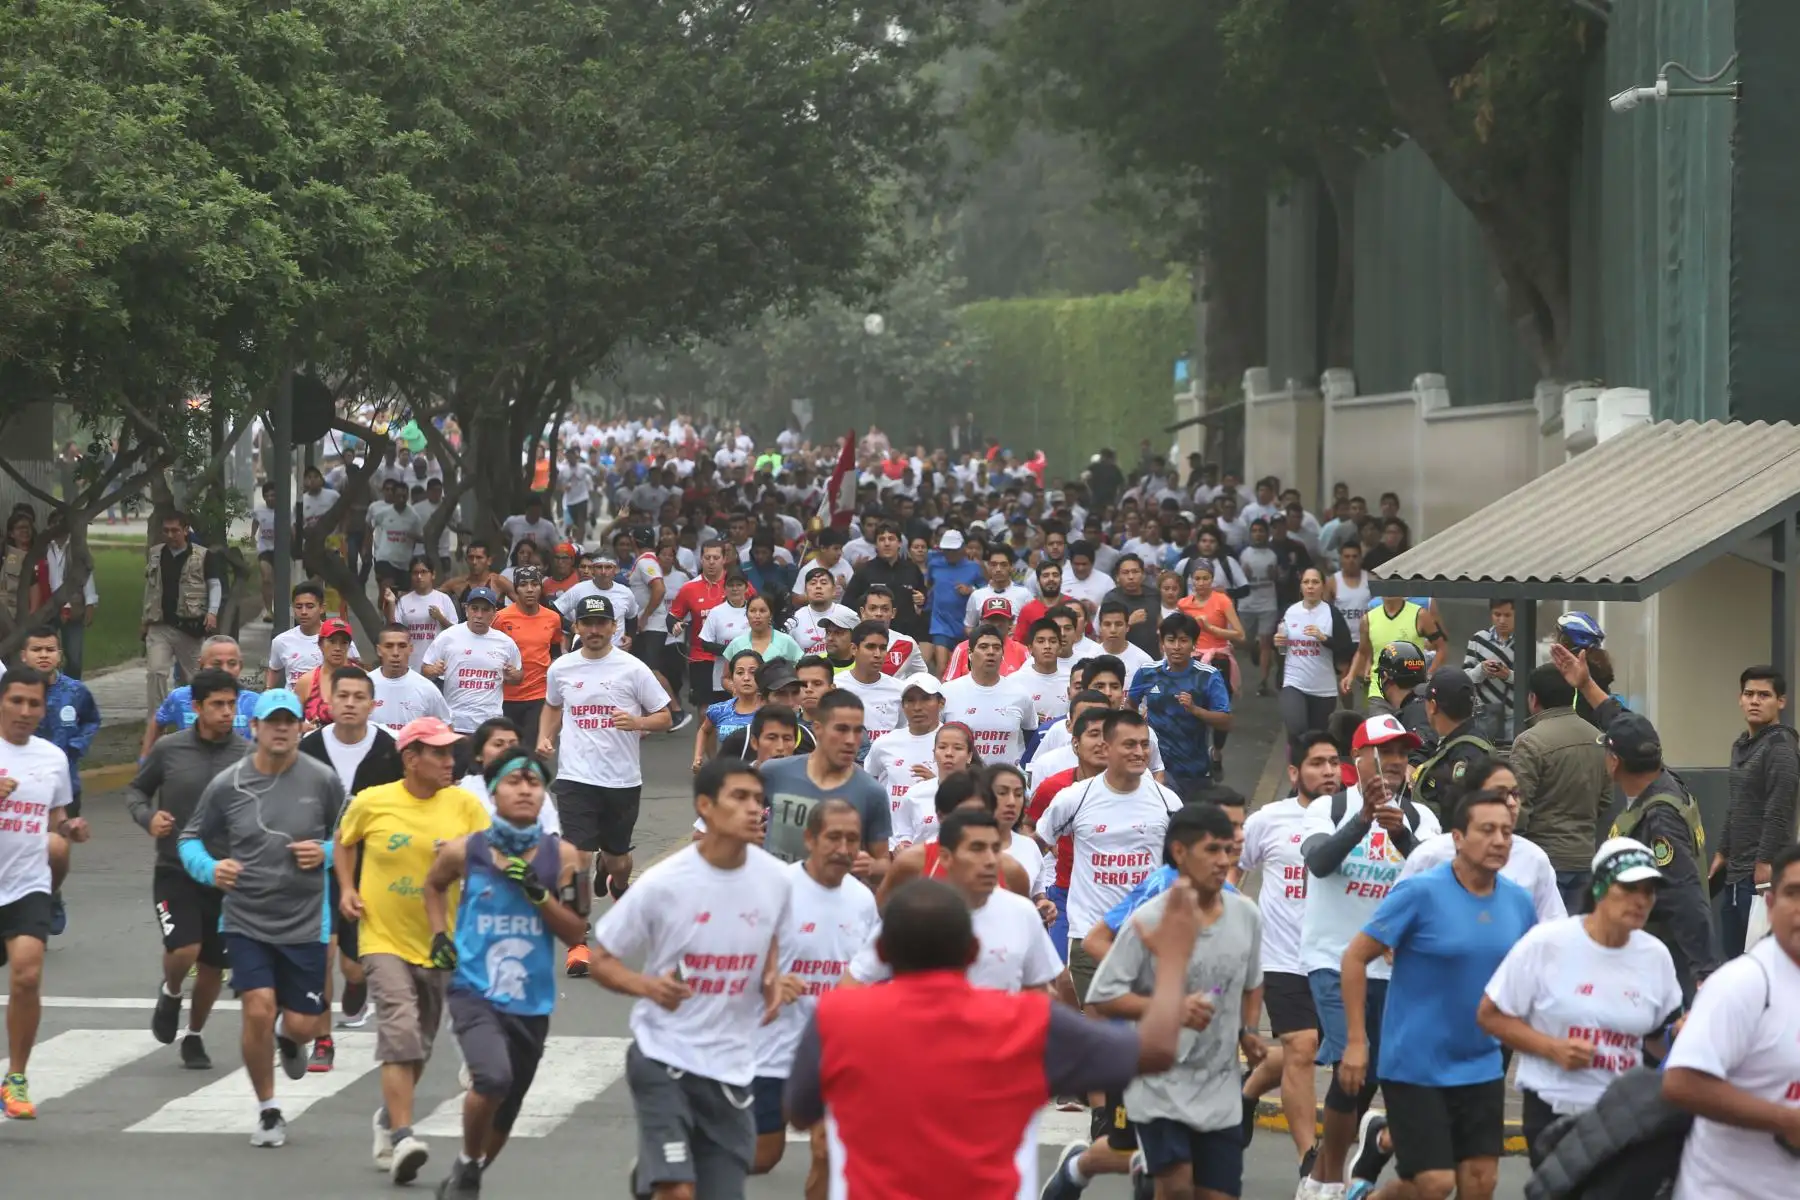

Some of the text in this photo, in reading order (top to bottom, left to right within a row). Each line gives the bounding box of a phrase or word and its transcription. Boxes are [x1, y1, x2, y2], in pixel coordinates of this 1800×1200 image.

[458, 668, 499, 679] DEPORTE
[992, 743, 1006, 755] 5K
[1092, 853, 1151, 867] DEPORTE
